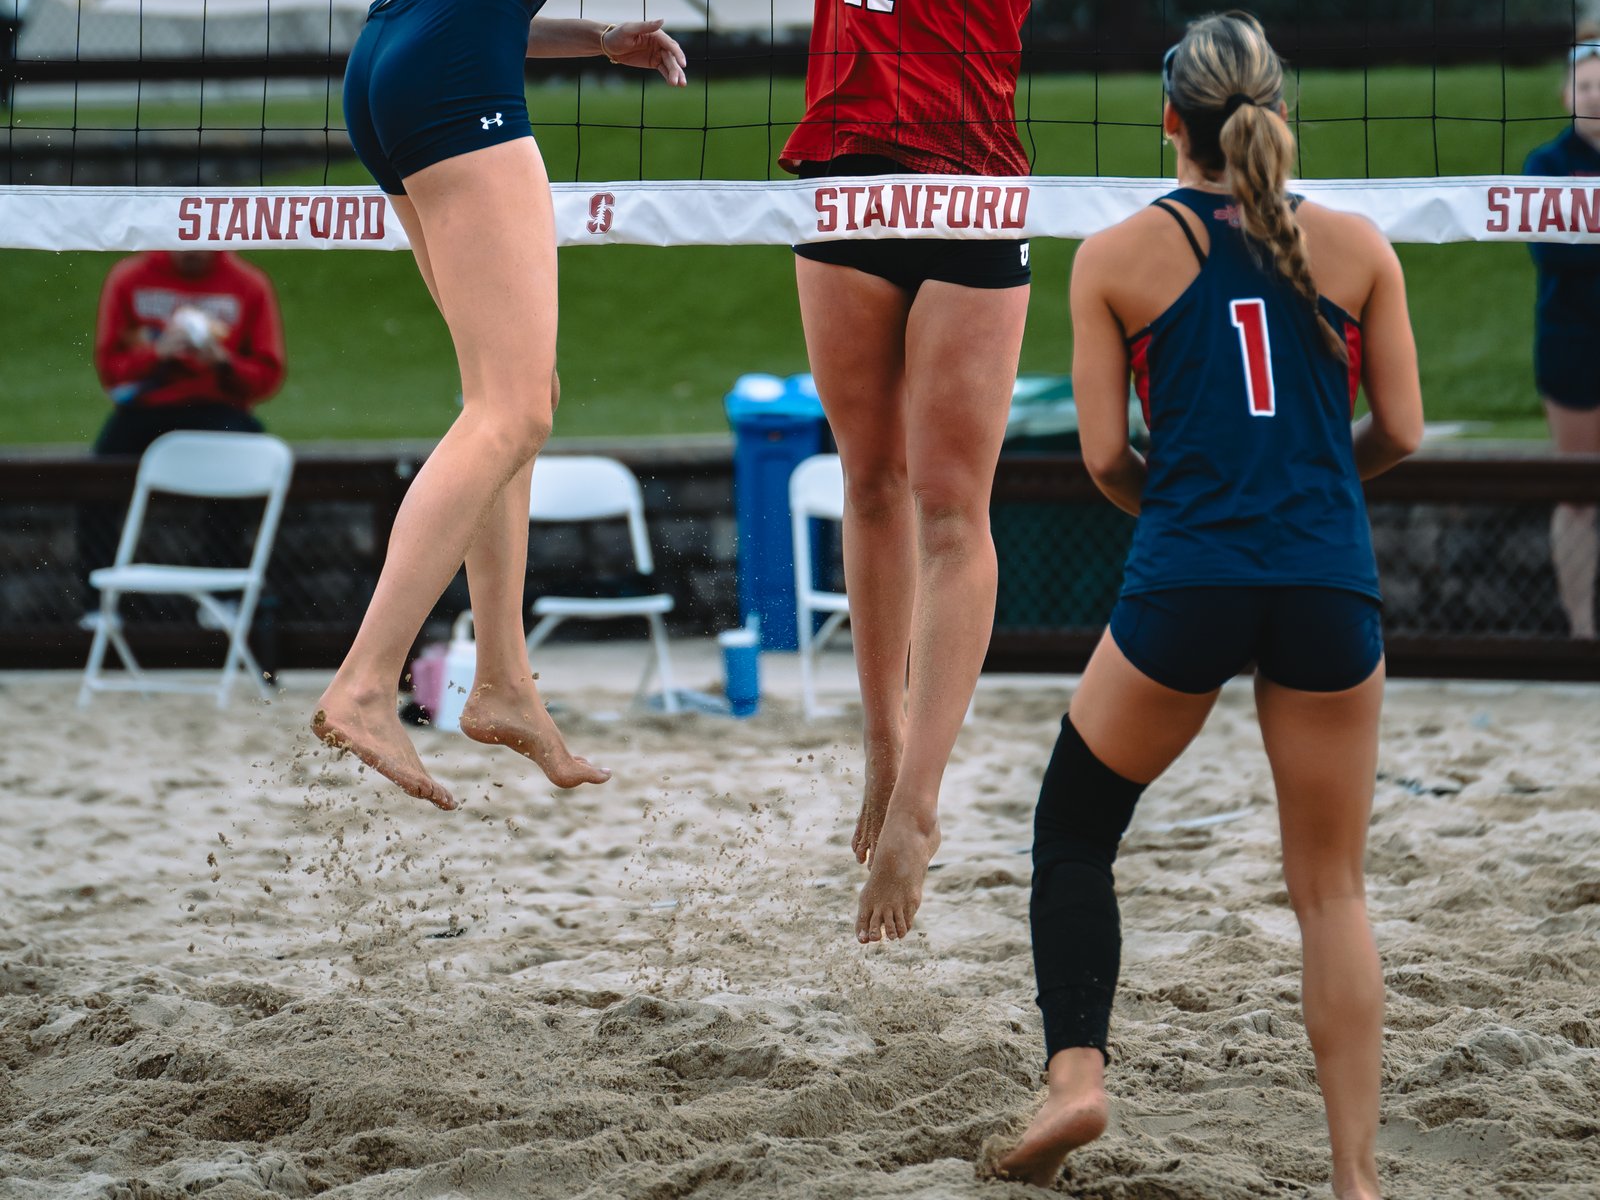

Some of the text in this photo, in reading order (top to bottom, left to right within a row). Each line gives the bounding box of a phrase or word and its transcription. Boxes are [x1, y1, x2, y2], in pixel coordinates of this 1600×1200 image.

[178, 196, 386, 241] STANFORD
[815, 185, 1030, 232] STANFORD
[1486, 187, 1600, 233] STAN
[1229, 298, 1276, 417] 1
